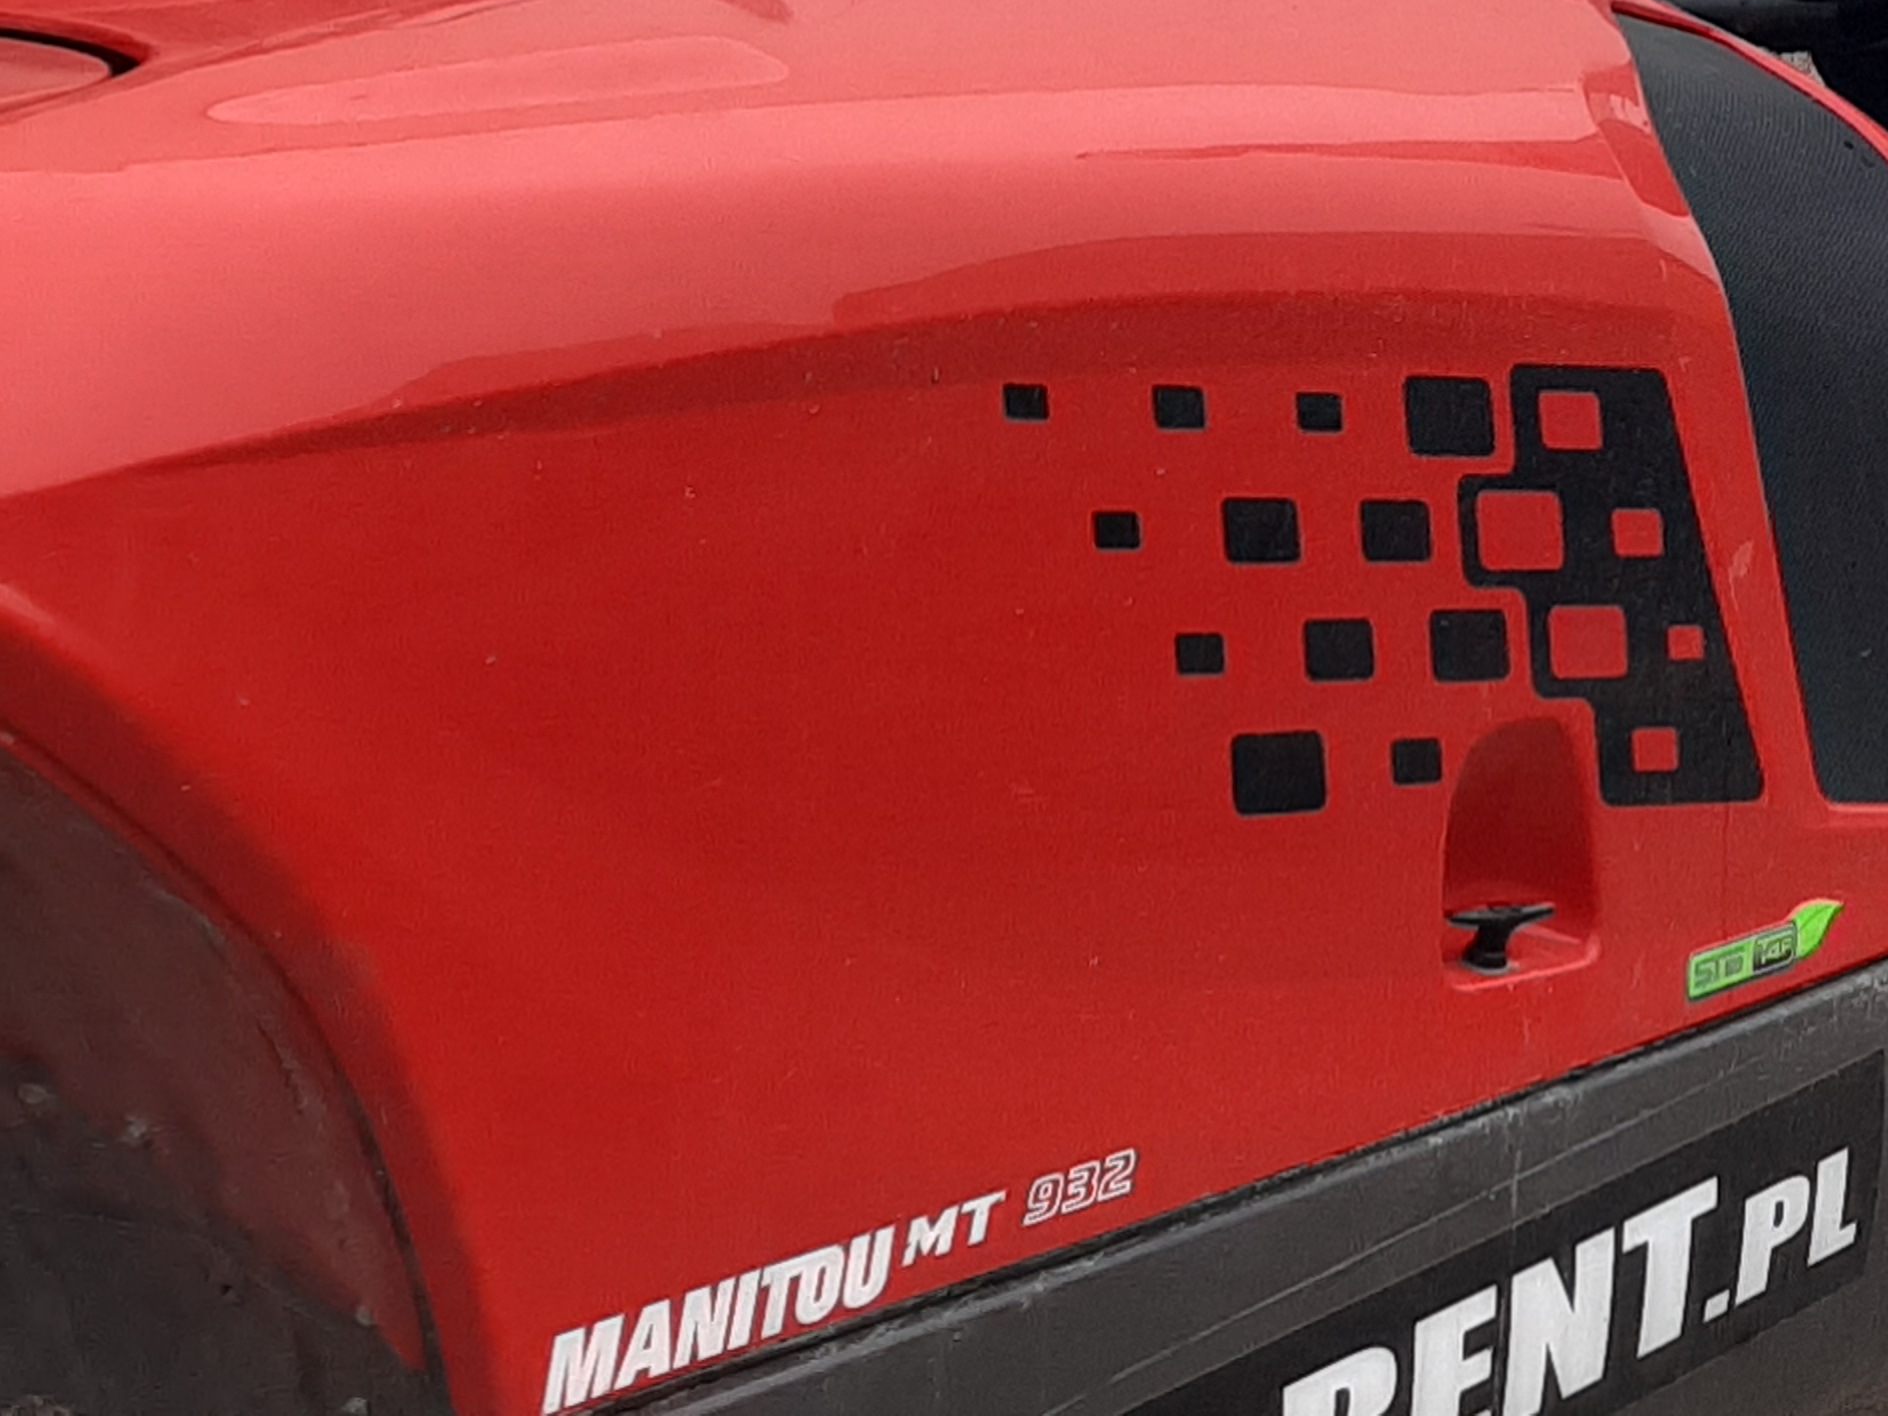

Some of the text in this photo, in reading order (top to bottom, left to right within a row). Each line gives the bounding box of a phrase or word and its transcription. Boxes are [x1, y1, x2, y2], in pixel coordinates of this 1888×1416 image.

[543, 1148, 1136, 1415] MANITOU MT 932
